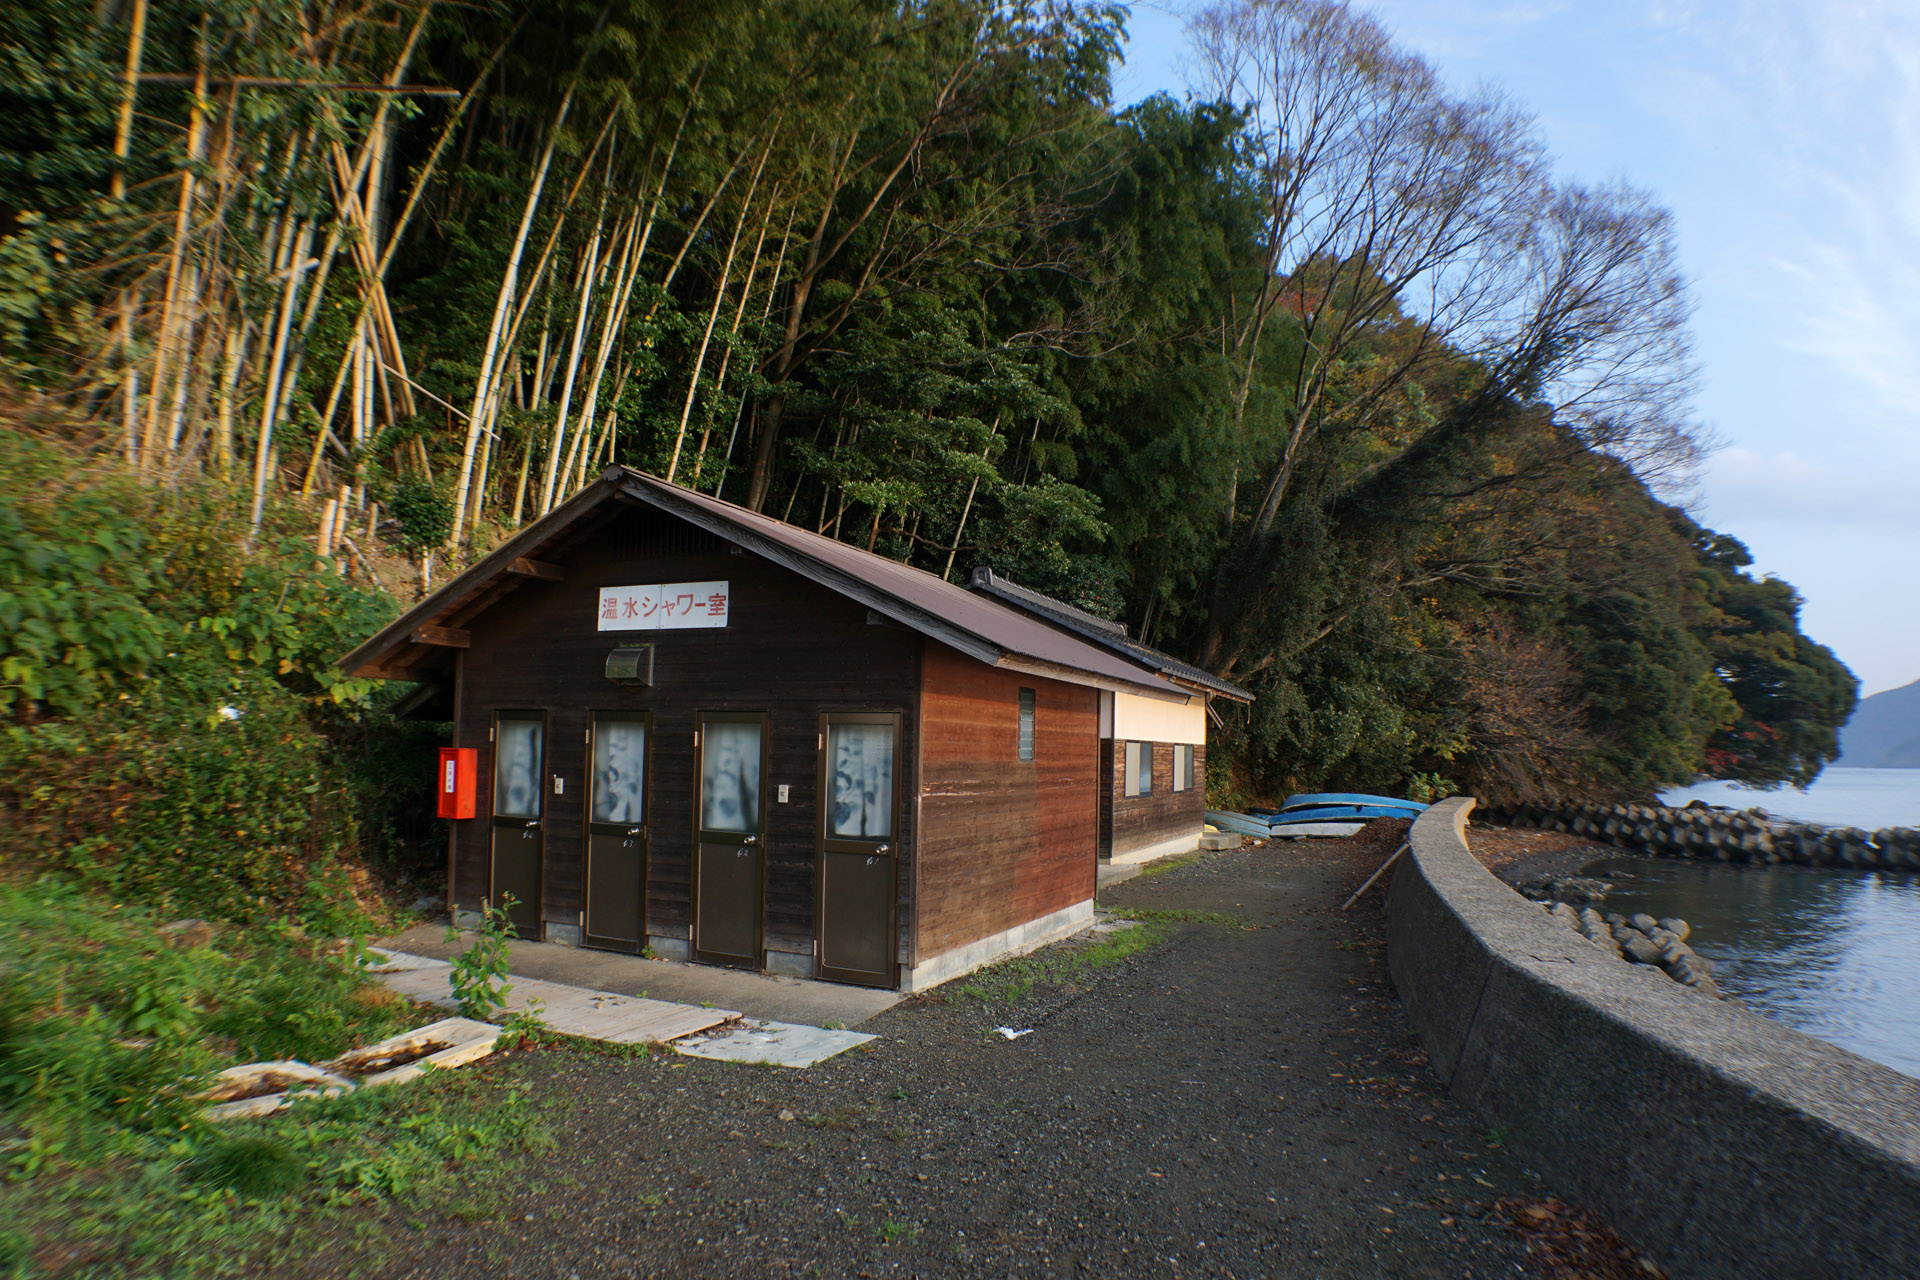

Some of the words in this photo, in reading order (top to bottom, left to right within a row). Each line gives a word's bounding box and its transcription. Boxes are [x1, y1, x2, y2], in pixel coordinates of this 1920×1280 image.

[601, 592, 727, 619] 温水シャワー室
